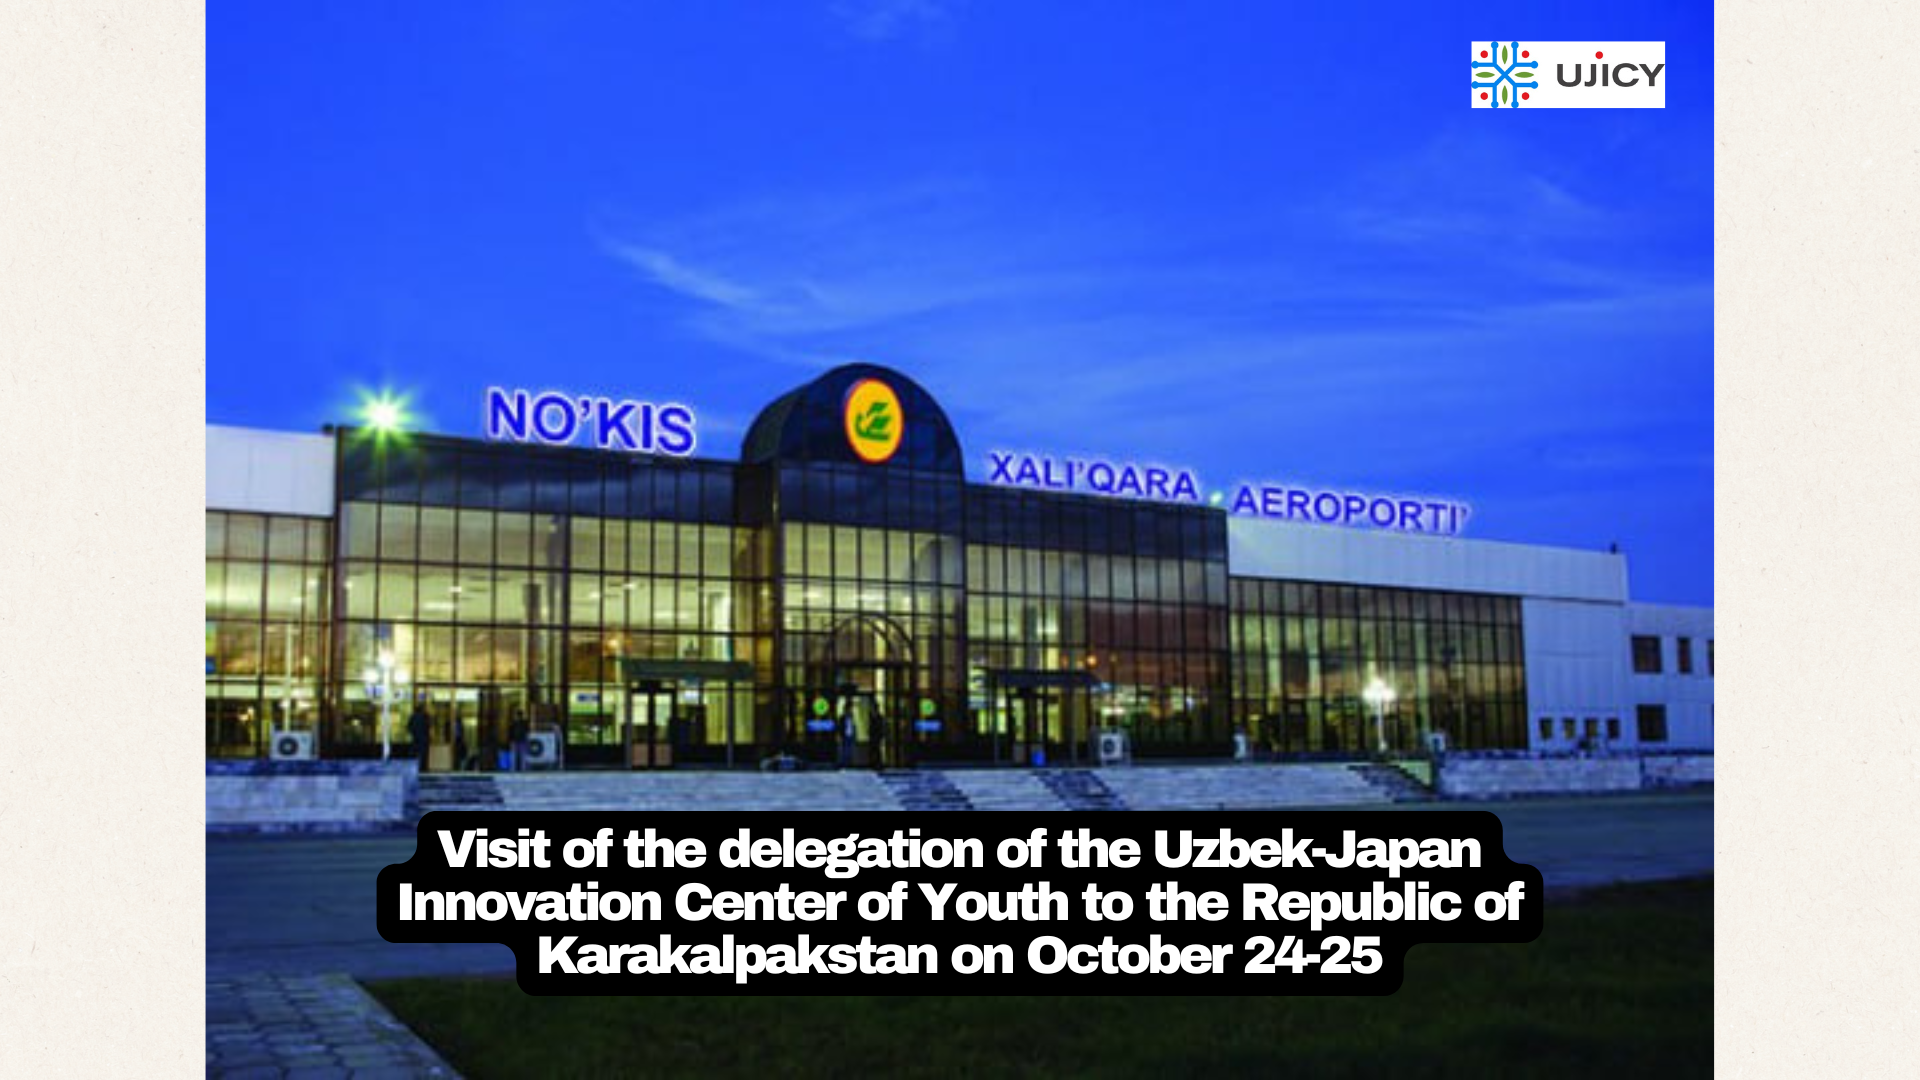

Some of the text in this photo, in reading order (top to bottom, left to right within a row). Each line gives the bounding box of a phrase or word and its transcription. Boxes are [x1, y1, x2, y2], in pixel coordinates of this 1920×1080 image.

[488, 389, 694, 455] NO'KIS
[990, 452, 1469, 534] XALI'QARA AEROPORTI'
